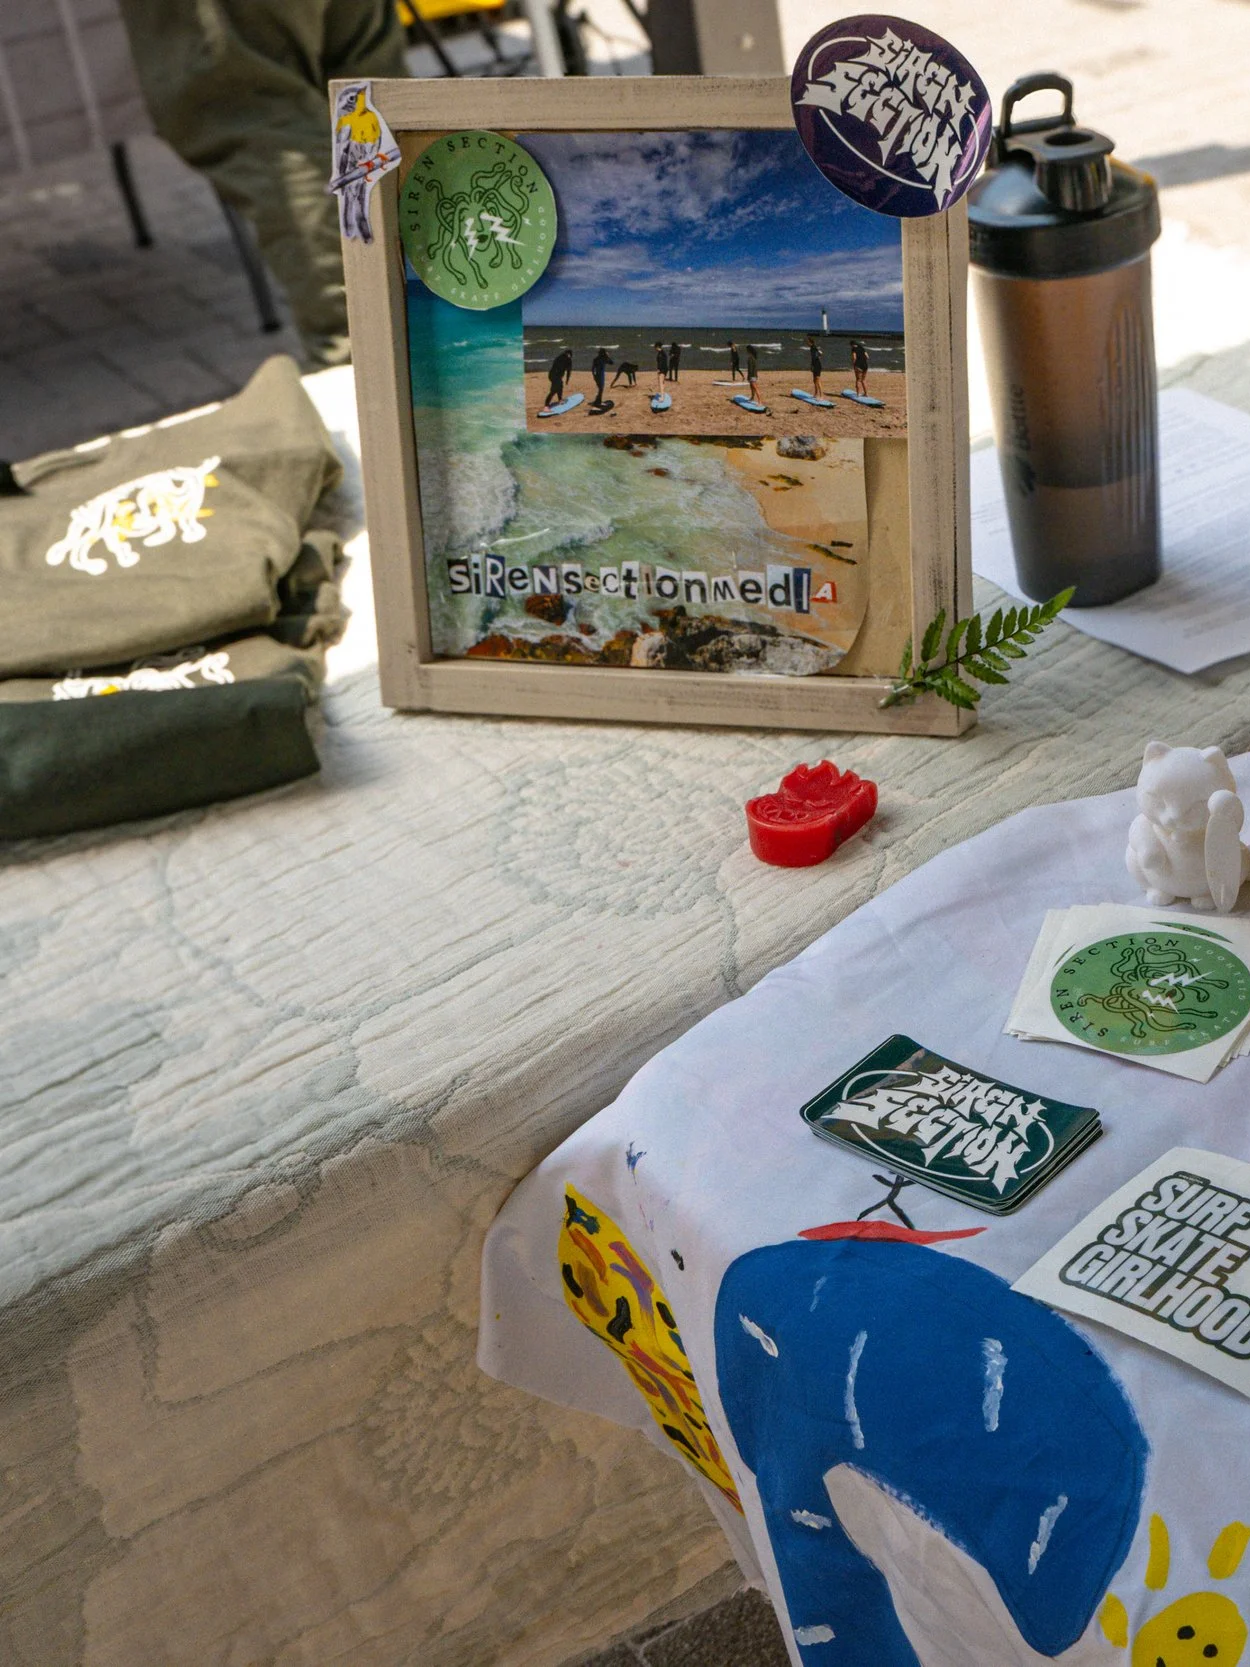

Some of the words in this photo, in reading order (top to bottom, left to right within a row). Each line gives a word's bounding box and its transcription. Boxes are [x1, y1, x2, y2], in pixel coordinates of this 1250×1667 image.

[794, 61, 964, 211] SECTION
[408, 154, 435, 233] SIREN
[446, 135, 539, 194] SECTION
[1064, 937, 1180, 976] SECTION
[1056, 988, 1109, 1037] SIREN
[820, 1088, 1032, 1195] SECTION
[1103, 1209, 1249, 1286] SKATE
